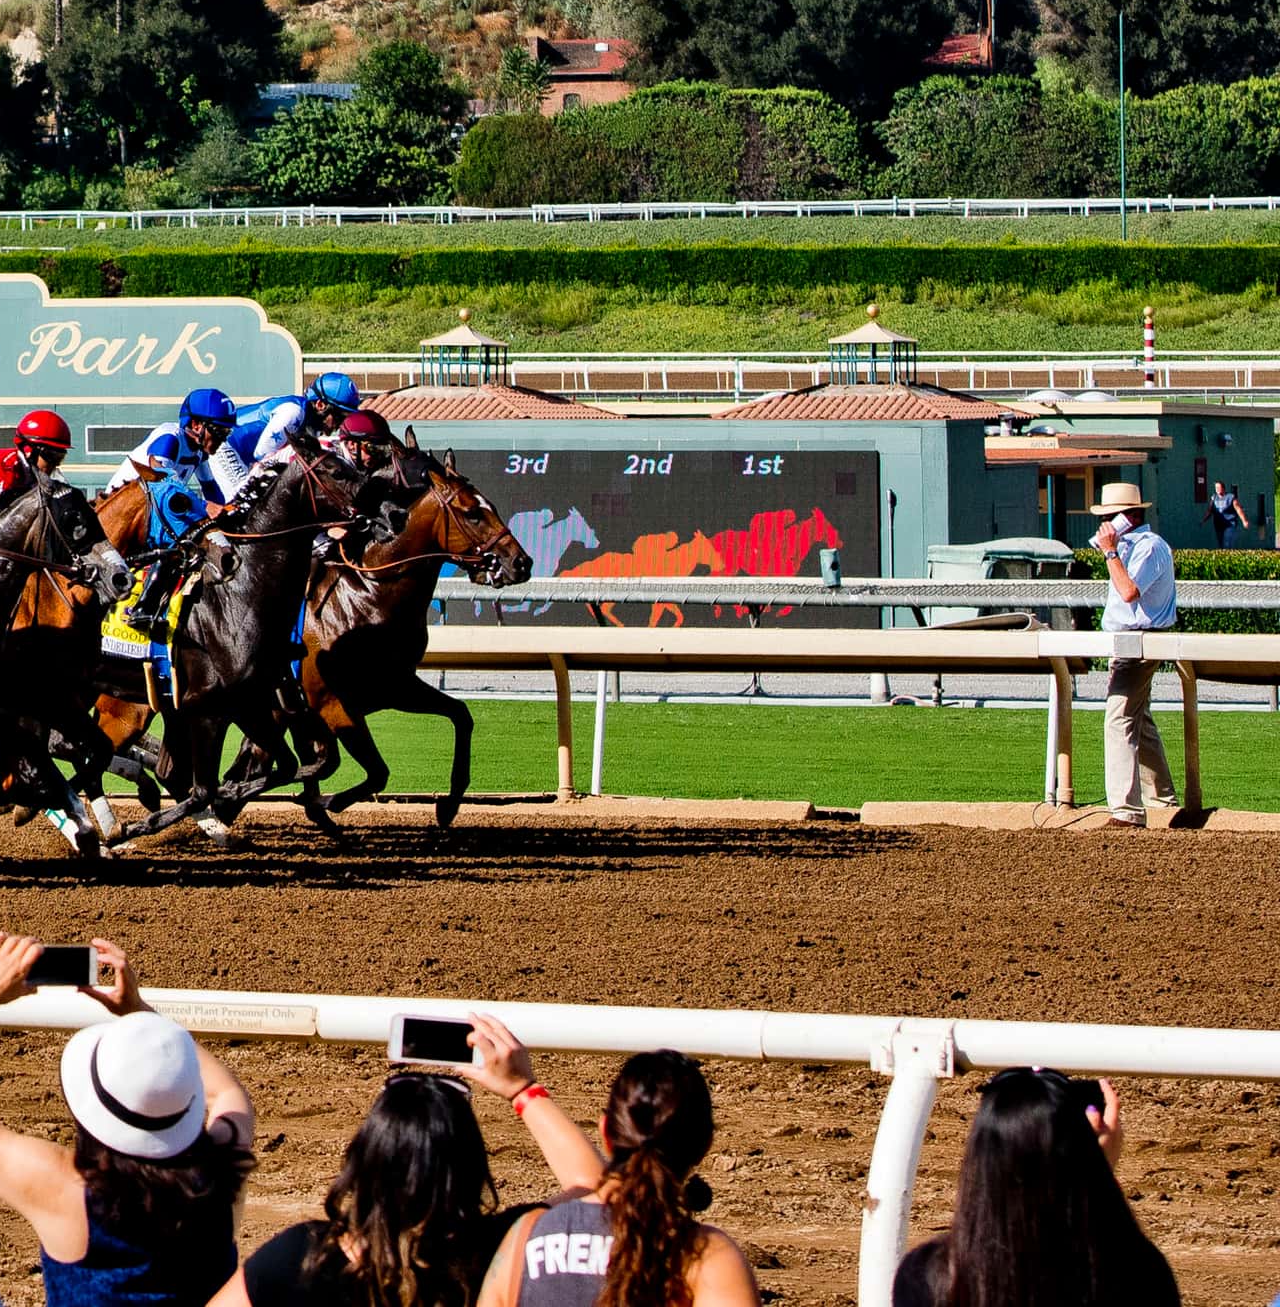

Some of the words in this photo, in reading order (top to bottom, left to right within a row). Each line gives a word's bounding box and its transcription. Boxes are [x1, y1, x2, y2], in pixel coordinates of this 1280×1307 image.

[505, 453, 549, 475] 3rd
[624, 453, 673, 475] 2nd
[742, 454, 784, 475] 1st
[152, 1004, 190, 1015] thorized
[195, 1004, 218, 1015] Plant
[222, 1007, 269, 1018] Personnel
[272, 1008, 296, 1020] Only
[525, 1232, 615, 1280] FREN
